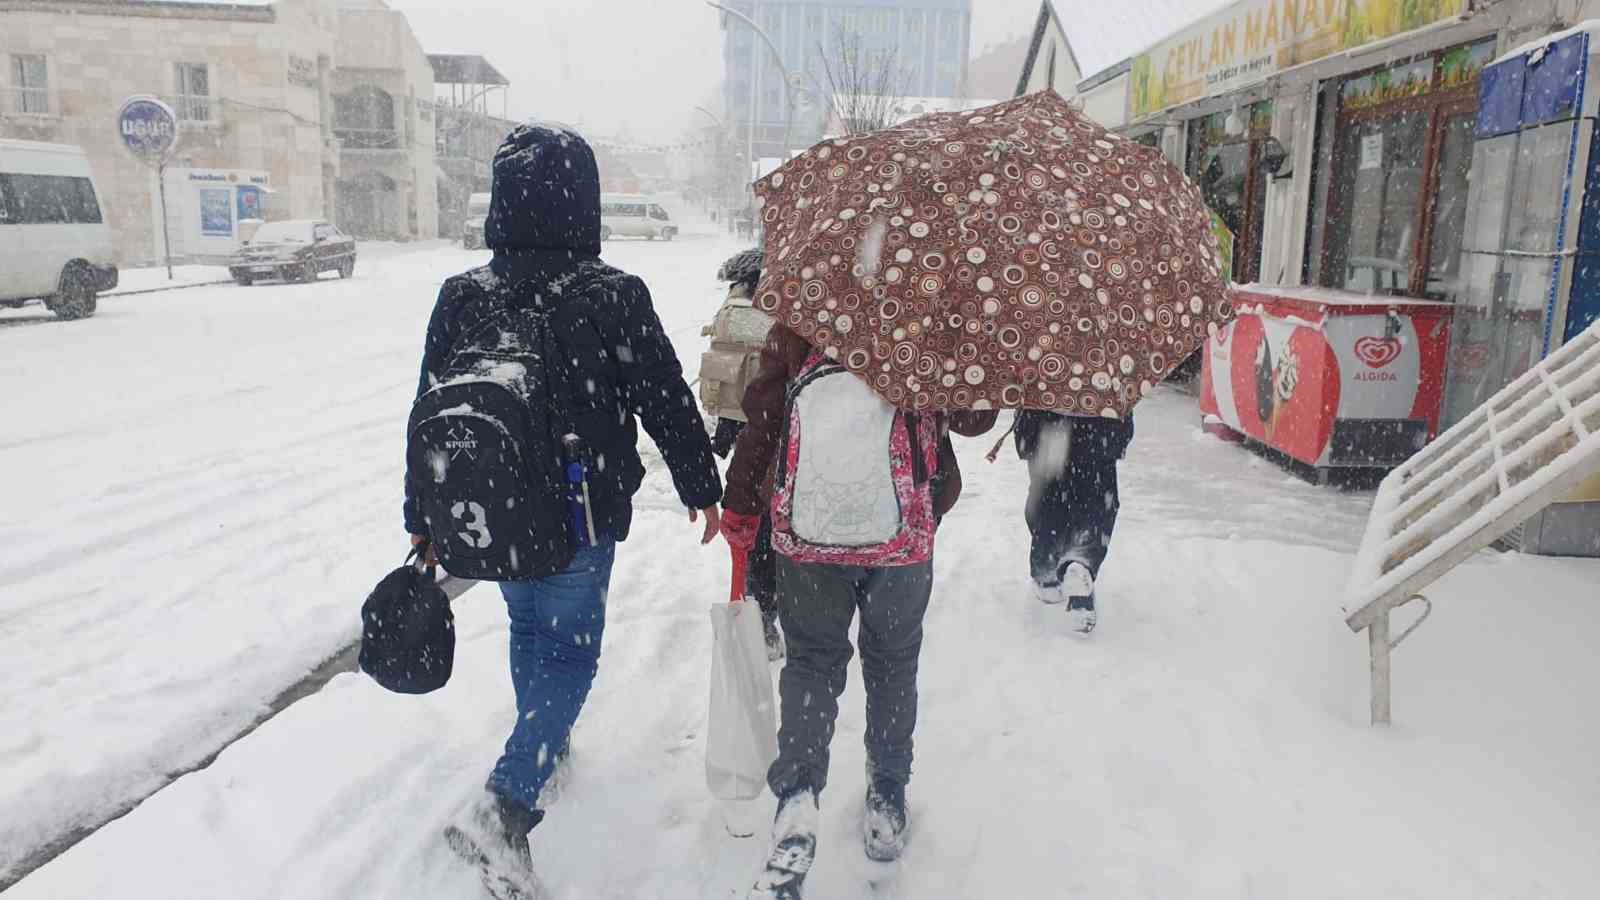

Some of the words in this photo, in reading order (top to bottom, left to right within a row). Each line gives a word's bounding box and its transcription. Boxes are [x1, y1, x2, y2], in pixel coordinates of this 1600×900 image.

[1167, 16, 1237, 83] CEYLAN
[1353, 372, 1398, 382] ALGIDA
[445, 440, 478, 449] SPORT
[450, 501, 493, 549] 3
